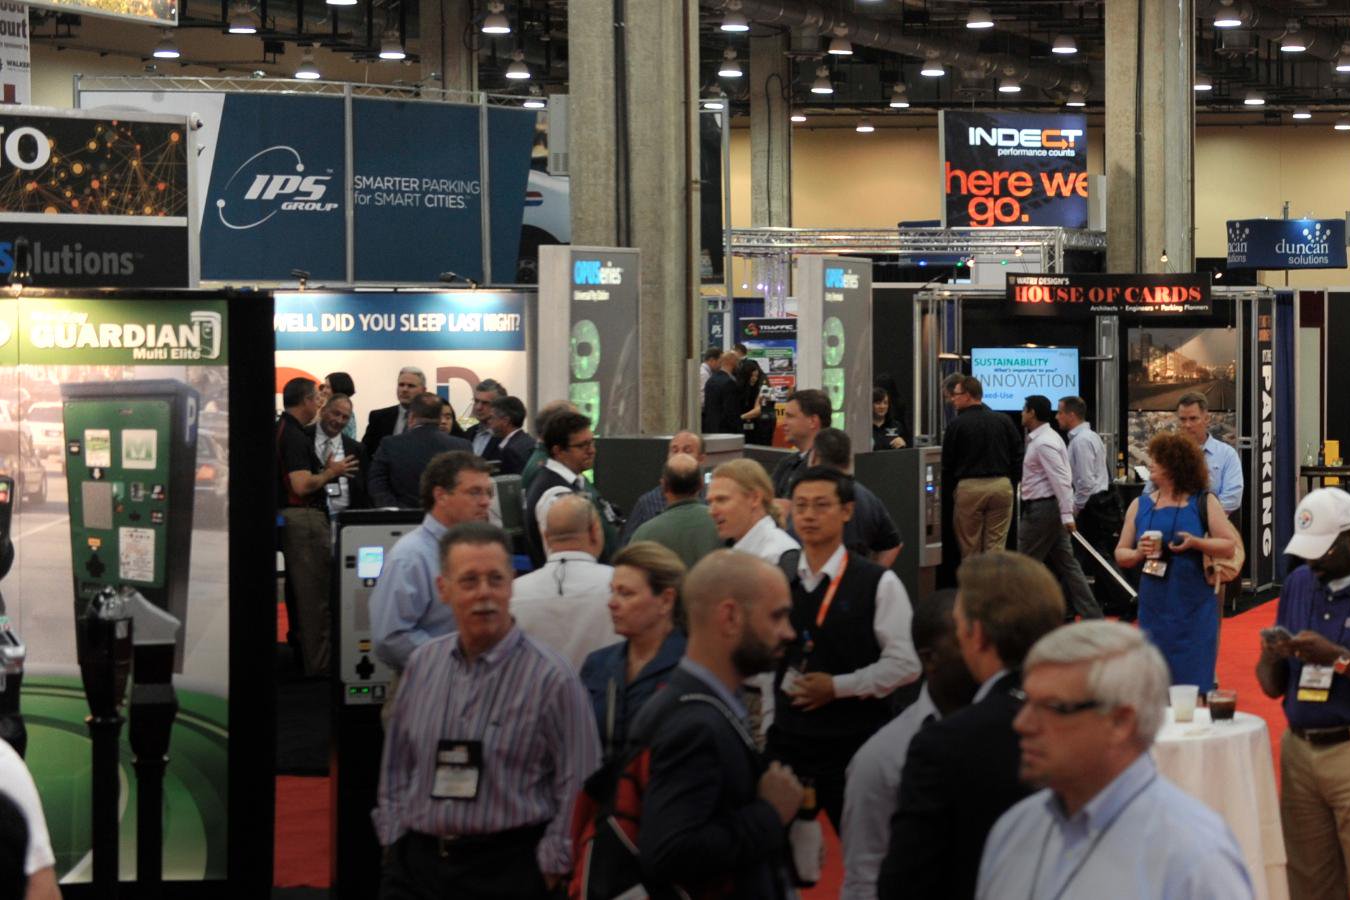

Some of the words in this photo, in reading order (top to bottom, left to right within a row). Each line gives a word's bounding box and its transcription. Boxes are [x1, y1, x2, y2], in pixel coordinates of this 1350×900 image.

[968, 127, 1083, 149] INDECT
[0, 126, 51, 170] O
[997, 147, 1047, 157] performance
[1048, 148, 1076, 157] counts
[244, 174, 332, 200] IPS
[354, 175, 420, 191] SMARTER
[422, 178, 481, 195] PARKING
[945, 161, 1033, 197] here
[1040, 171, 1088, 198] we
[281, 200, 338, 212] GROUP
[354, 191, 372, 206] for
[374, 192, 420, 208] SMART
[968, 196, 1030, 227] go.
[1275, 239, 1329, 254] duncan
[1288, 254, 1329, 265] solutions
[1015, 286, 1085, 303] HOUSE
[1088, 287, 1121, 303] OF
[1124, 287, 1202, 303] CARDS
[321, 313, 355, 332] DID
[358, 313, 396, 332] YOU
[400, 313, 447, 332] SLEEP
[448, 313, 483, 332] LAST
[30, 323, 200, 348] GUARDIAN
[133, 347, 168, 360] Multi
[170, 347, 201, 360] Elite
[974, 358, 1049, 367] SUSTAINABILITY
[1262, 365, 1273, 558] PARKING
